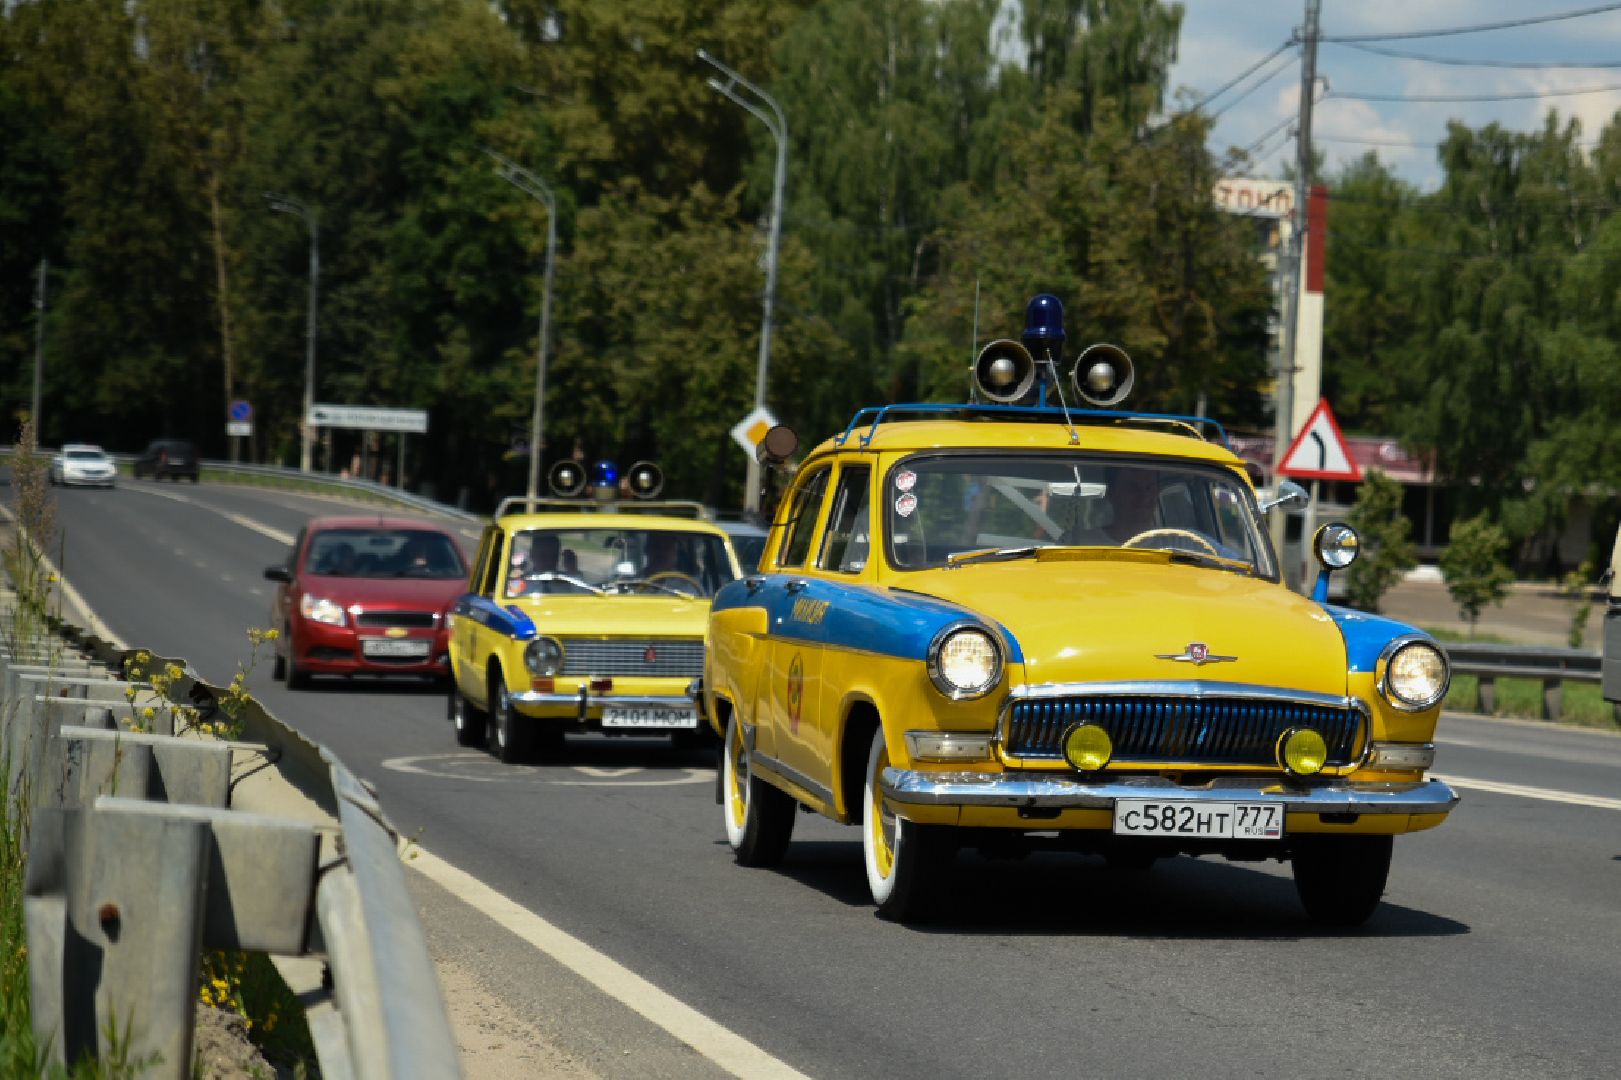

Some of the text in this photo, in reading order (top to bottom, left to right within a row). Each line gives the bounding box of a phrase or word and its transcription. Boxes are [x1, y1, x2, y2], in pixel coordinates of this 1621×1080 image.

[610, 709, 647, 724] 2101
[1124, 804, 1276, 833] С582НТ 777
[1244, 826, 1264, 836] RUS
